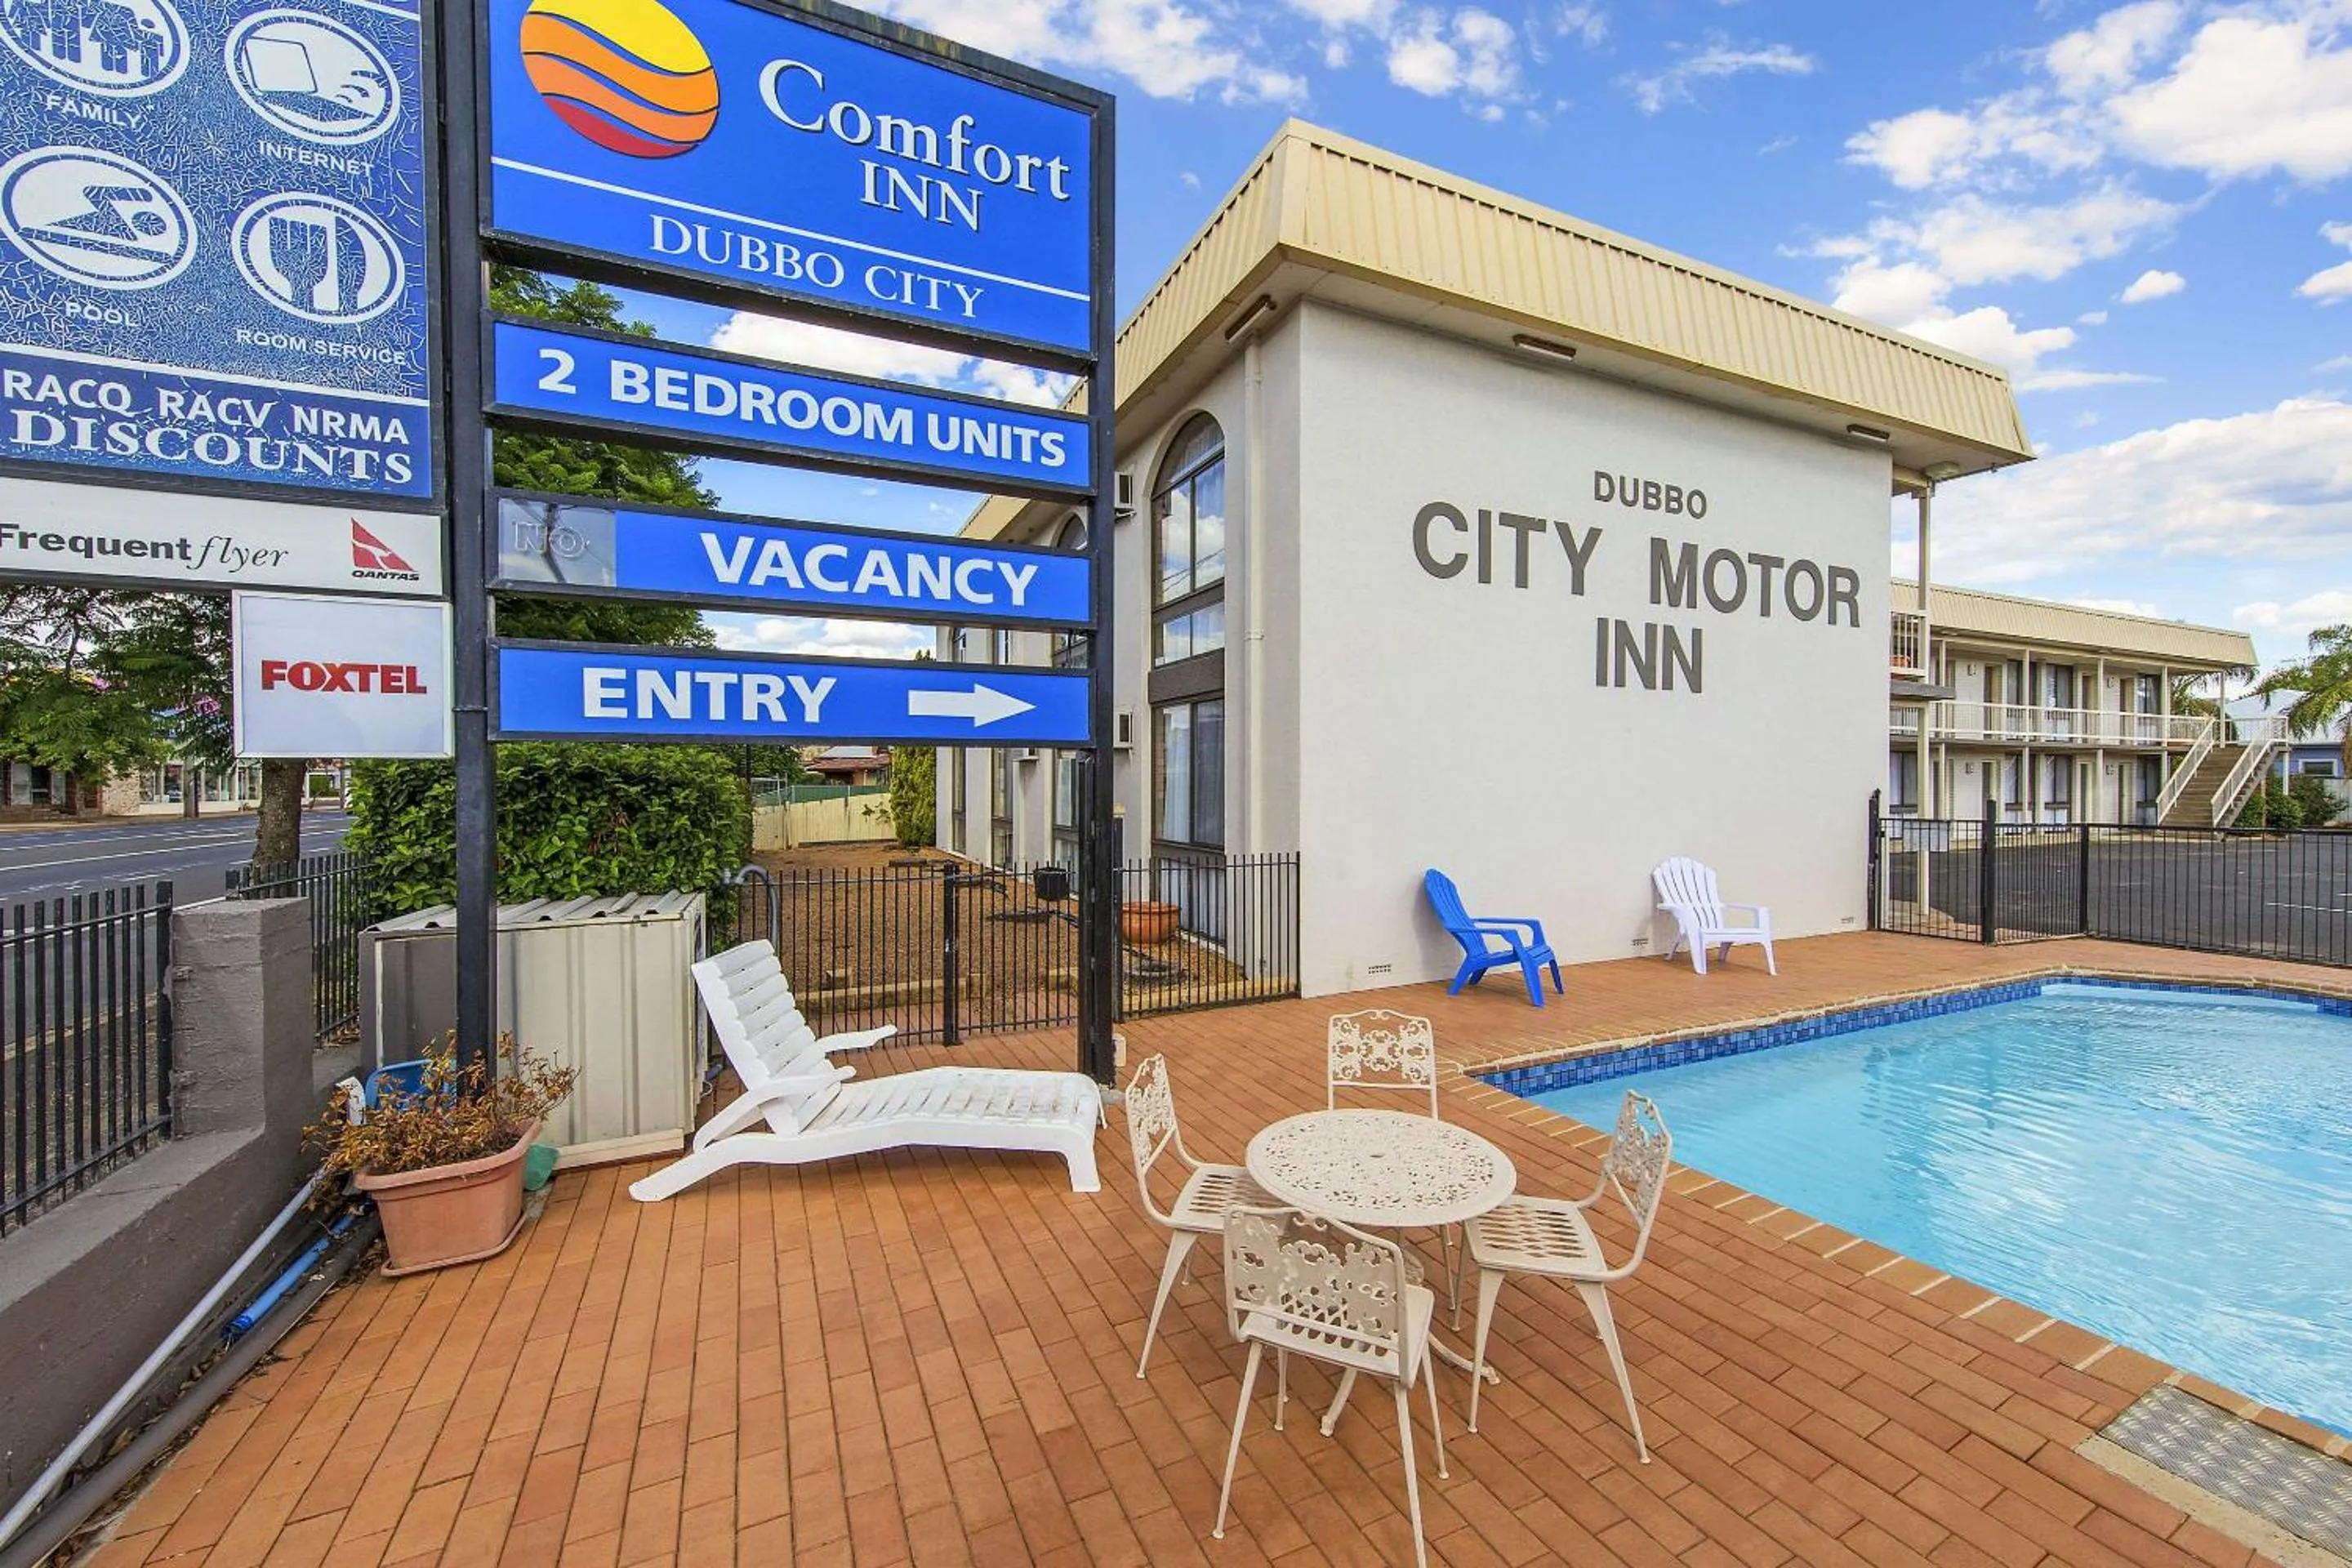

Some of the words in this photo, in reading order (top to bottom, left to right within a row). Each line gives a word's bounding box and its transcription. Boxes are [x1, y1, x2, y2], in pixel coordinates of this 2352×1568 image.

[46, 96, 142, 129] FAMILY
[759, 58, 1071, 201] Comfort
[259, 140, 375, 177] INTERNET
[859, 158, 984, 233] INN
[649, 214, 844, 288] DUBBO
[864, 265, 984, 318] CITY
[65, 301, 138, 327] POOL
[235, 328, 307, 352] ROOM
[314, 336, 406, 365] SERVICE
[2, 369, 142, 415] RACQ
[158, 387, 274, 428] RACV
[292, 404, 409, 444] NRMA
[537, 349, 577, 394] 2
[610, 359, 914, 445] BEDROOM
[927, 415, 1066, 467] UNITS
[9, 409, 412, 483] DISCOUNTS
[1594, 470, 1708, 519] DUBBO
[187, 535, 288, 573] flyer
[351, 570, 420, 581] QANTAS
[700, 532, 1039, 607] VACANCY
[1412, 501, 1603, 596] CITY
[1650, 537, 1861, 628] MOTOR
[261, 659, 427, 693] FOXTEL
[1595, 617, 1703, 693] INN
[582, 666, 837, 724] ENTRY
